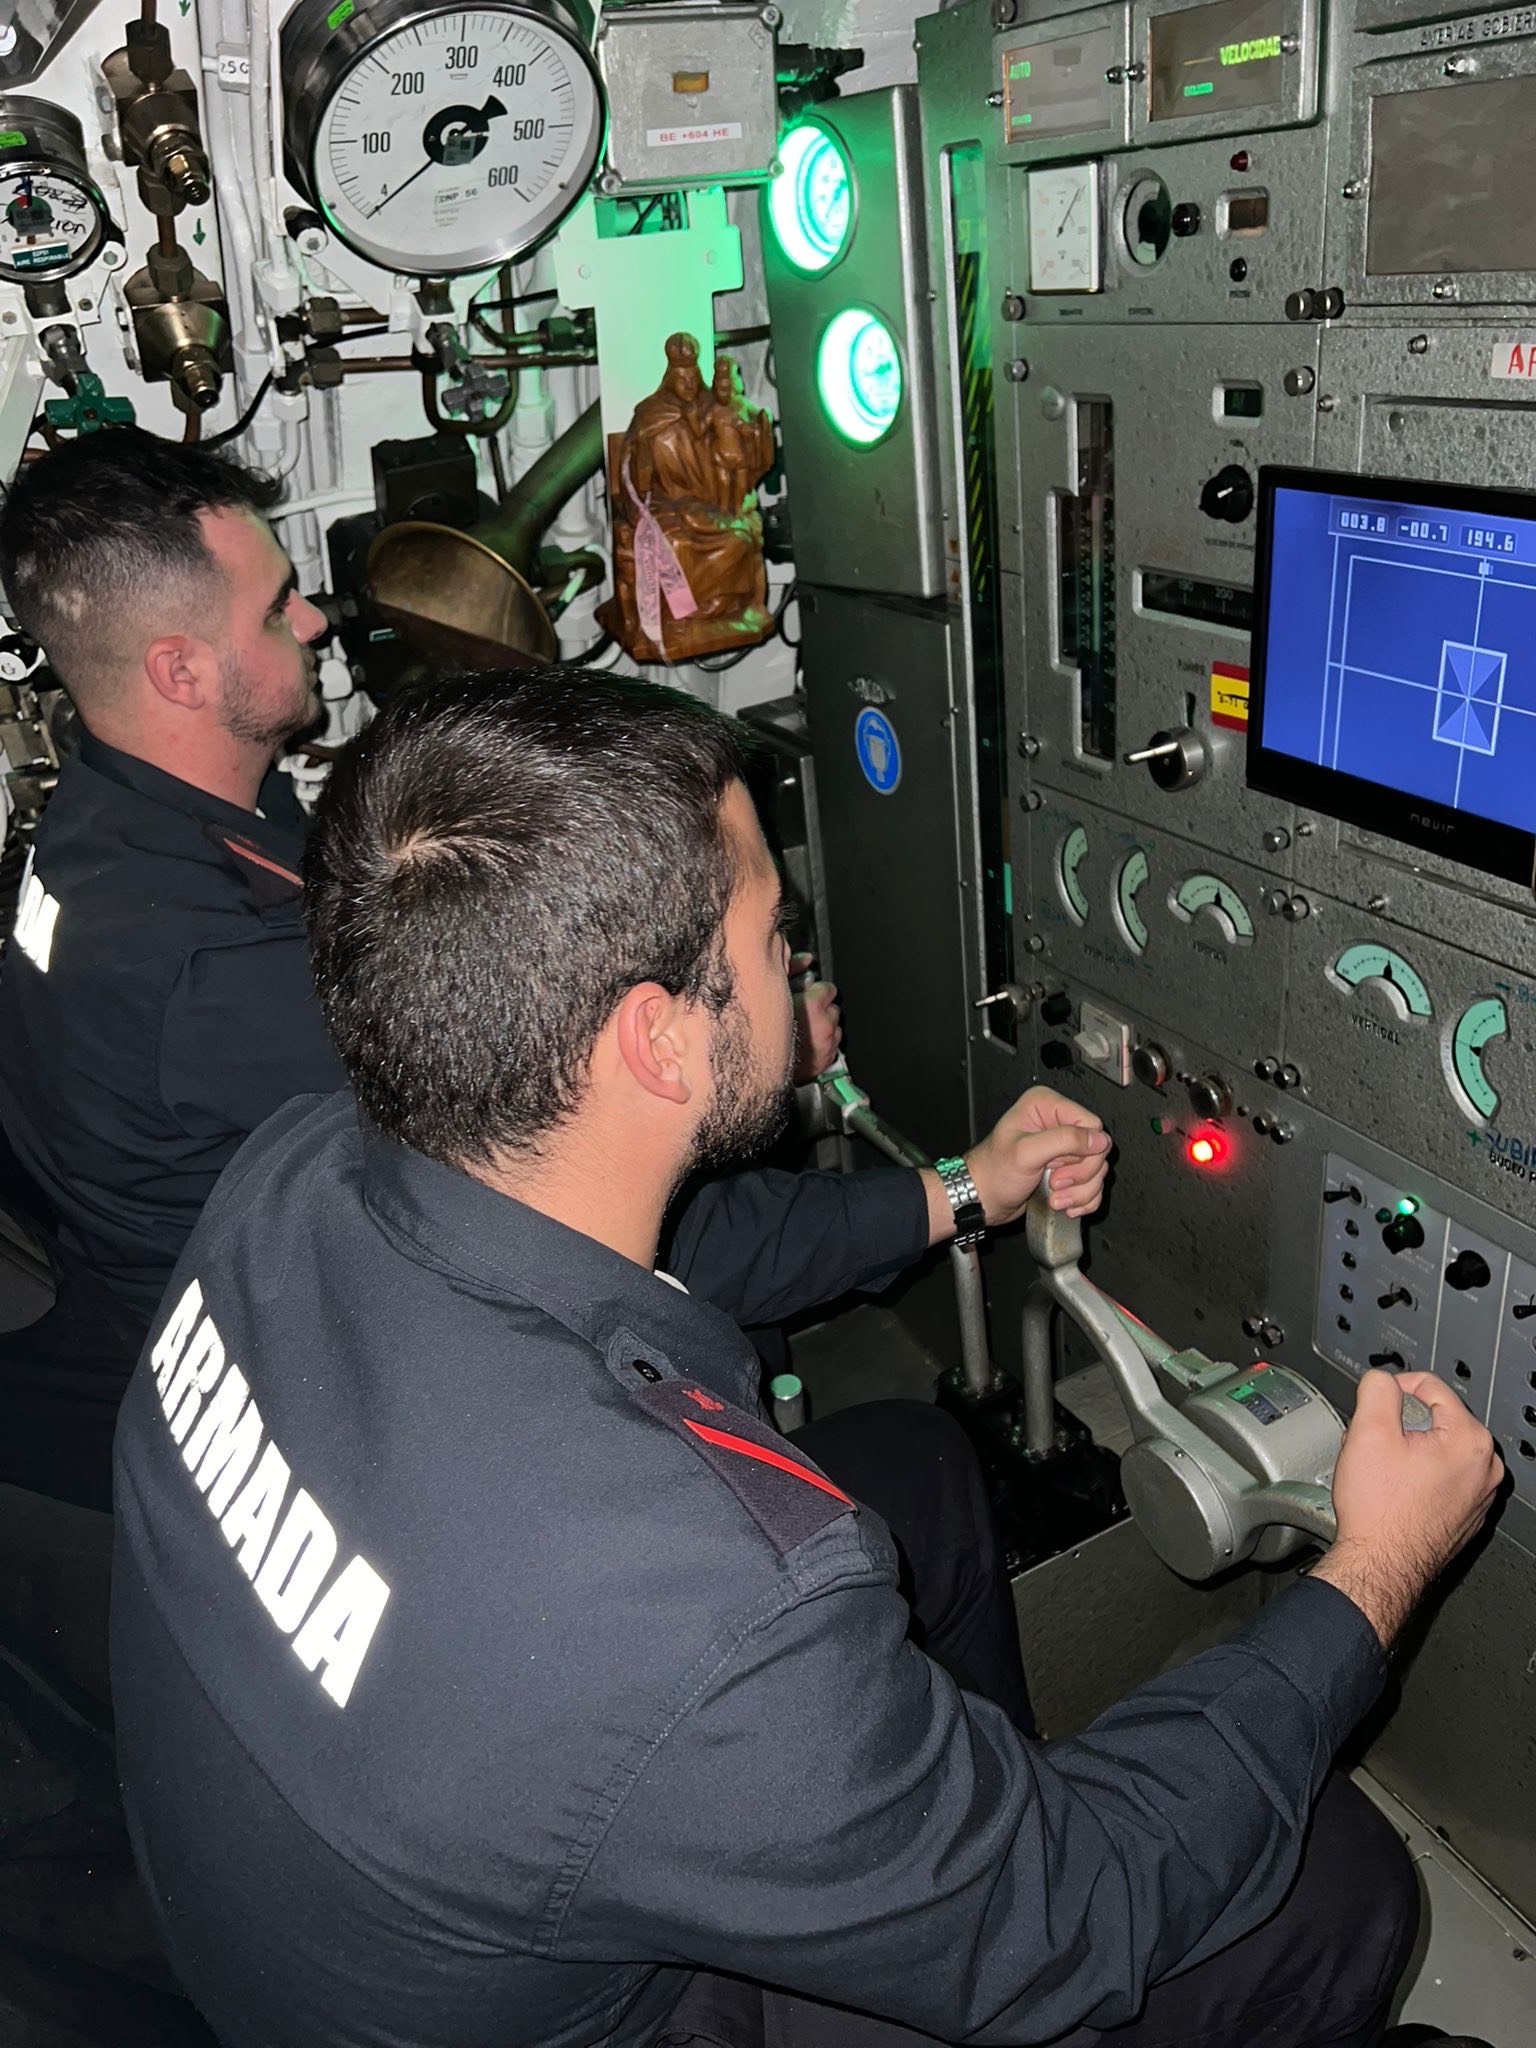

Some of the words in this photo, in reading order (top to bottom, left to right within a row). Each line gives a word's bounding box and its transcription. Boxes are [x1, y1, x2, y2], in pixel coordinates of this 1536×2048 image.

[1483, 11, 1536, 37] GOBIER
[445, 45, 478, 70] 300
[1220, 35, 1281, 66] VELOCIDAD
[391, 72, 424, 96] 200
[493, 64, 526, 88] 400
[513, 118, 545, 141] 500
[660, 132, 676, 142] BE
[713, 127, 729, 137] HE
[361, 131, 391, 154] 100
[488, 165, 519, 188] 600
[380, 183, 388, 197] 4
[1341, 511, 1386, 533] 003.8
[1400, 521, 1448, 542] -00.7
[1467, 529, 1514, 552] 194.6
[1410, 812, 1456, 834] nevir
[151, 1278, 391, 1709] ARMADA
